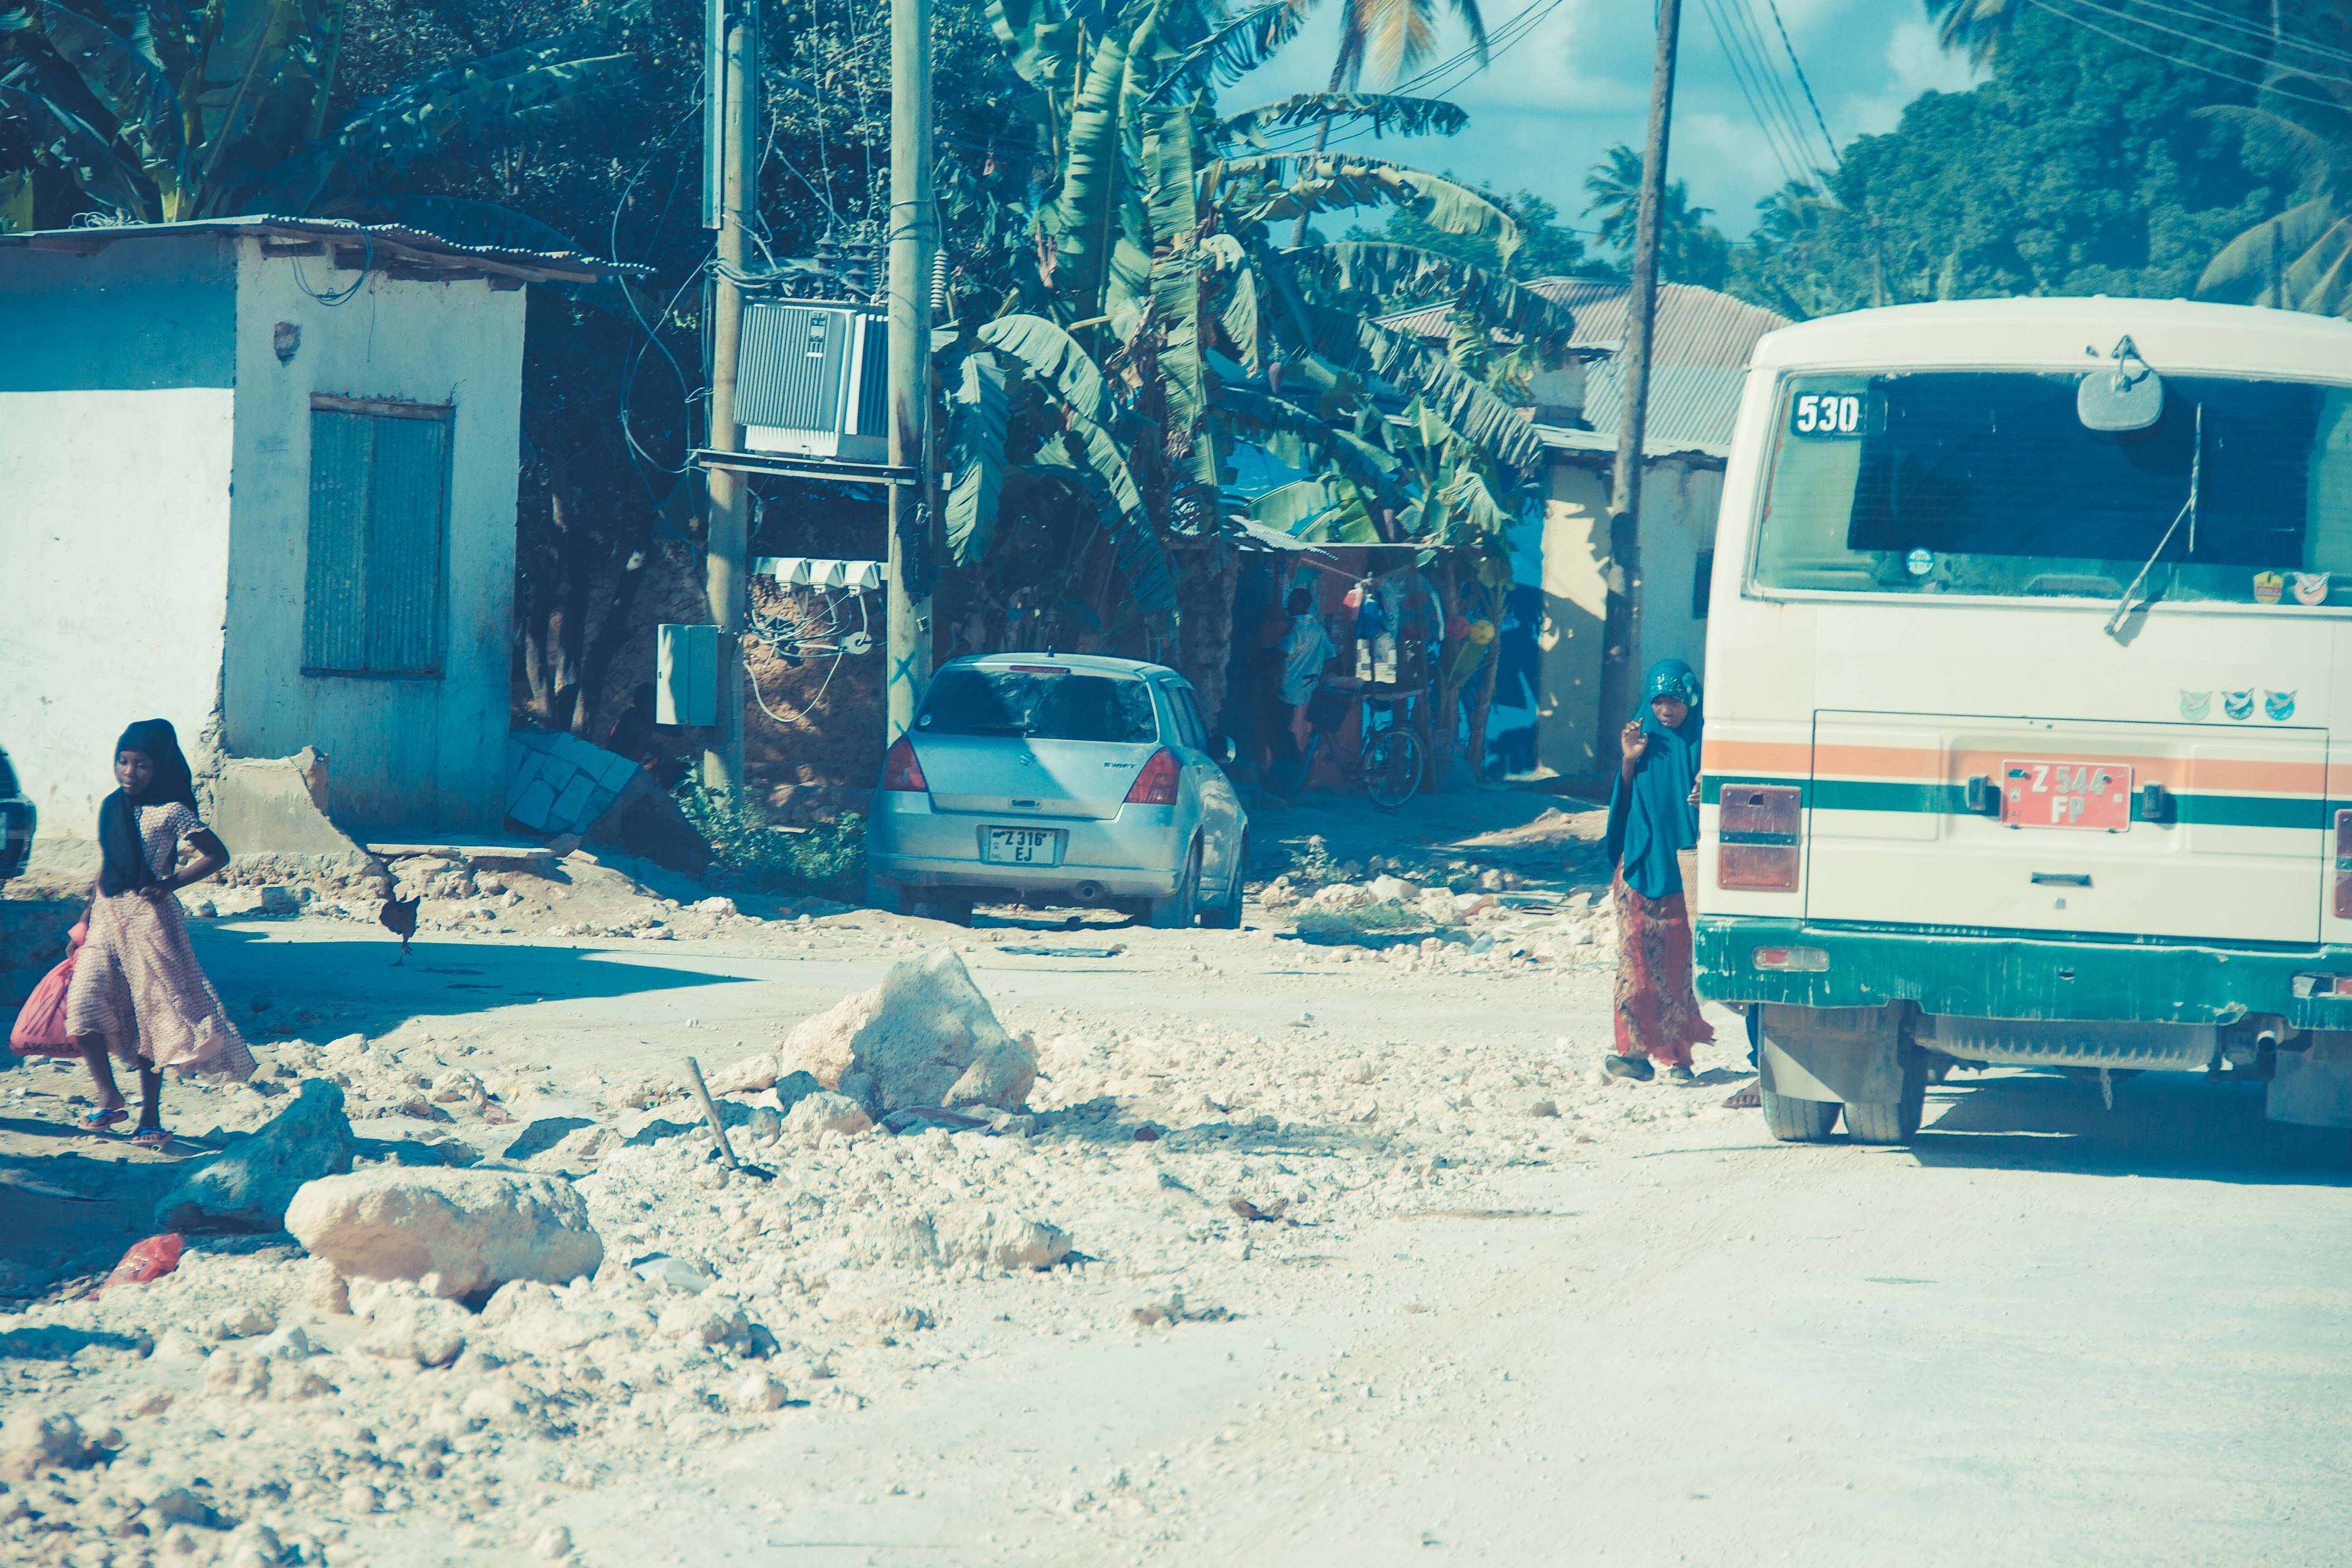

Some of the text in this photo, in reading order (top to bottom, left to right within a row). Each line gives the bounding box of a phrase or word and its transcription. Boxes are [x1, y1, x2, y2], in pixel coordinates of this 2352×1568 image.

[1797, 395, 1859, 432] 530
[2032, 765, 2106, 796] Z 544
[2051, 796, 2085, 824] FP
[1005, 831, 1043, 847] Z 316
[1015, 847, 1033, 862] EJ
